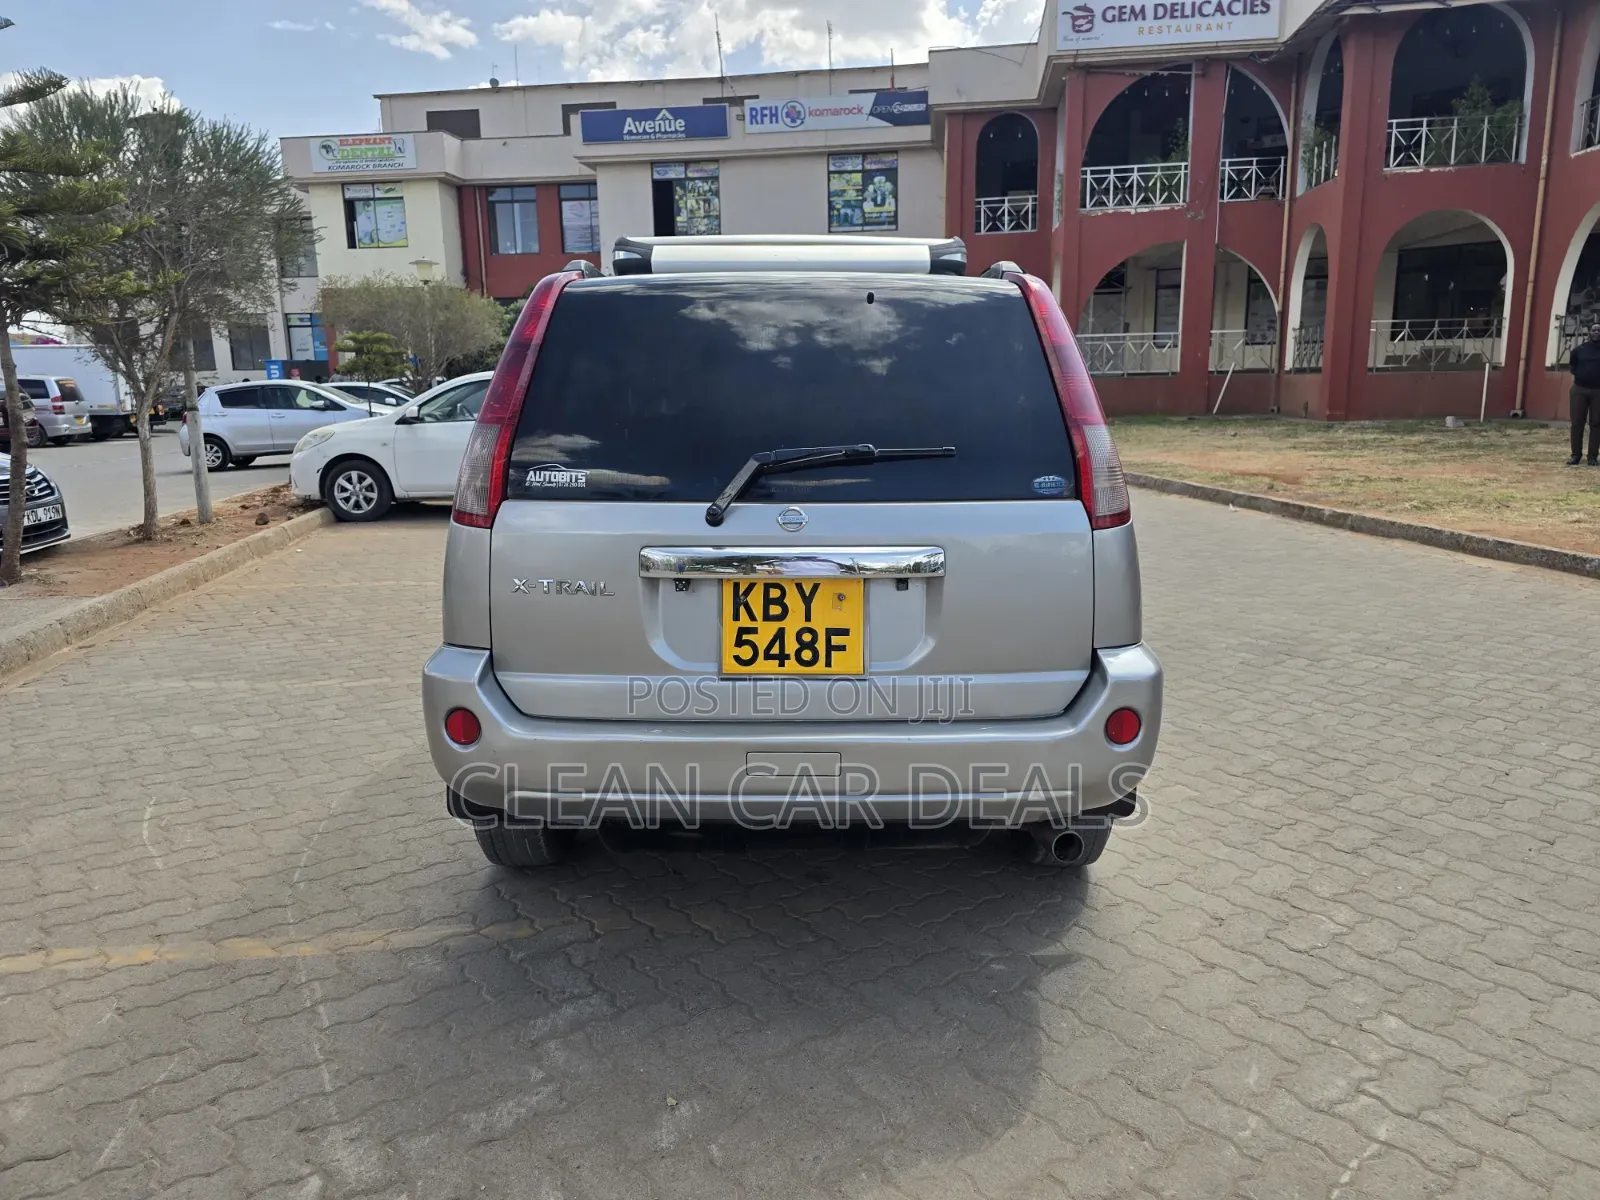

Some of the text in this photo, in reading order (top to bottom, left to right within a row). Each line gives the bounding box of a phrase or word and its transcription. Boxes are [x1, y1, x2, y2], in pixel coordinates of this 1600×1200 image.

[1101, 0, 1271, 23] GEM DELICACIES
[1138, 22, 1233, 36] RESTAURANT
[749, 104, 864, 125] RFH komarock
[872, 105, 892, 114] OPEN
[623, 117, 686, 134] Avenue
[339, 137, 392, 146] ELEPHANT
[340, 147, 395, 159] DENTAL
[328, 163, 370, 171] KOMAROCK
[526, 470, 586, 482] AUTOBITS
[27, 505, 61, 524] KDL 919N
[510, 578, 615, 596] X-TRAIL
[732, 582, 821, 622] KBY
[732, 626, 850, 667] 548F
